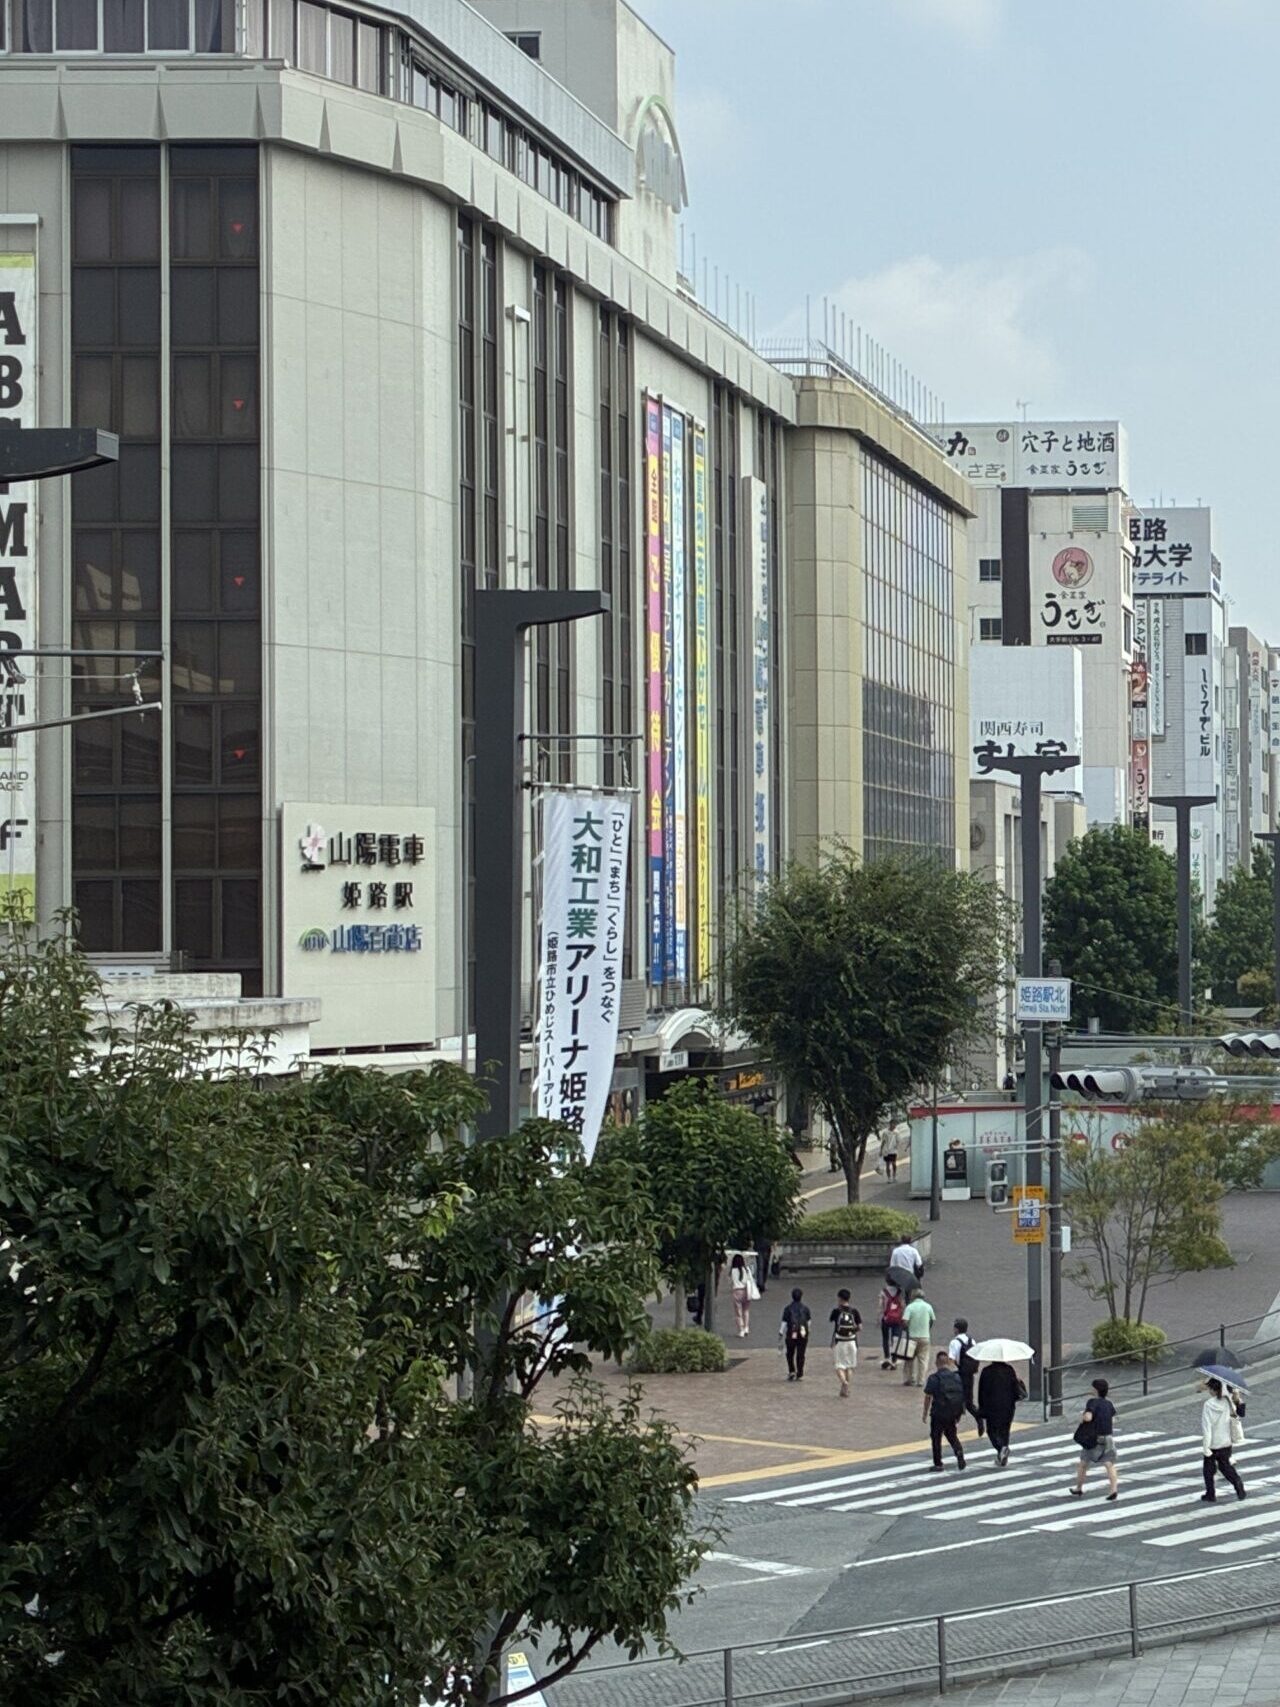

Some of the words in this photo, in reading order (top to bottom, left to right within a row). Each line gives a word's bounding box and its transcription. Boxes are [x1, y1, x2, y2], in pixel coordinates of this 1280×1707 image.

[1021, 431, 1115, 453] 穴子と地酒
[1065, 461, 1107, 476] うさぎ
[1133, 571, 1188, 585] テライト
[1040, 592, 1106, 630] うさぎ
[980, 721, 1044, 736] 関西寿司
[329, 831, 425, 865] 山陽電車
[342, 881, 413, 908] 姫路駅
[331, 924, 422, 953] 山陽百貨店
[1020, 986, 1066, 1003] 姫路駅北
